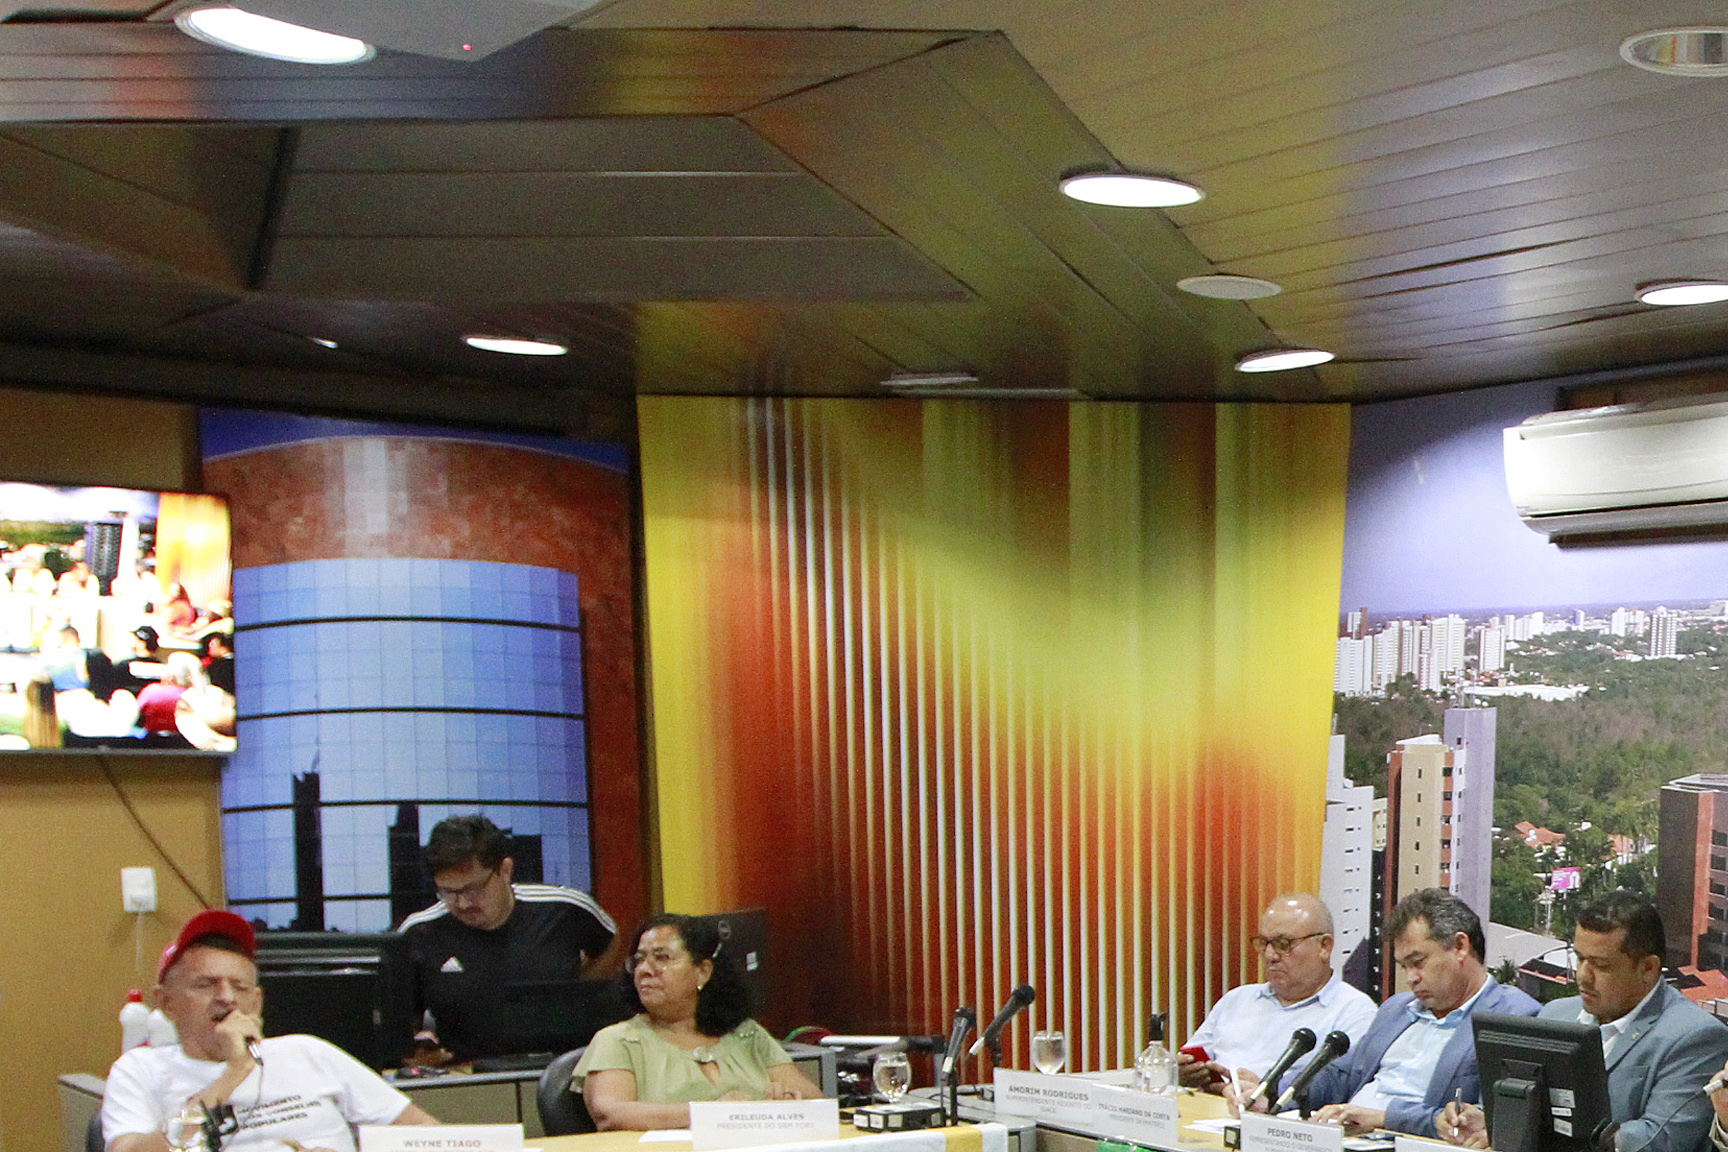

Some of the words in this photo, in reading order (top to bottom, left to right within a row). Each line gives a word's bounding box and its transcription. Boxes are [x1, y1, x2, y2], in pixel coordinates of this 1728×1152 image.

[1008, 1085, 1040, 1096] AMORIM
[1043, 1088, 1089, 1101] RODRIGUES
[1267, 1128, 1291, 1139] PEDRO
[1293, 1132, 1313, 1142] NETO
[403, 1140, 442, 1148] WEYNE
[446, 1139, 481, 1148] TIAGO
